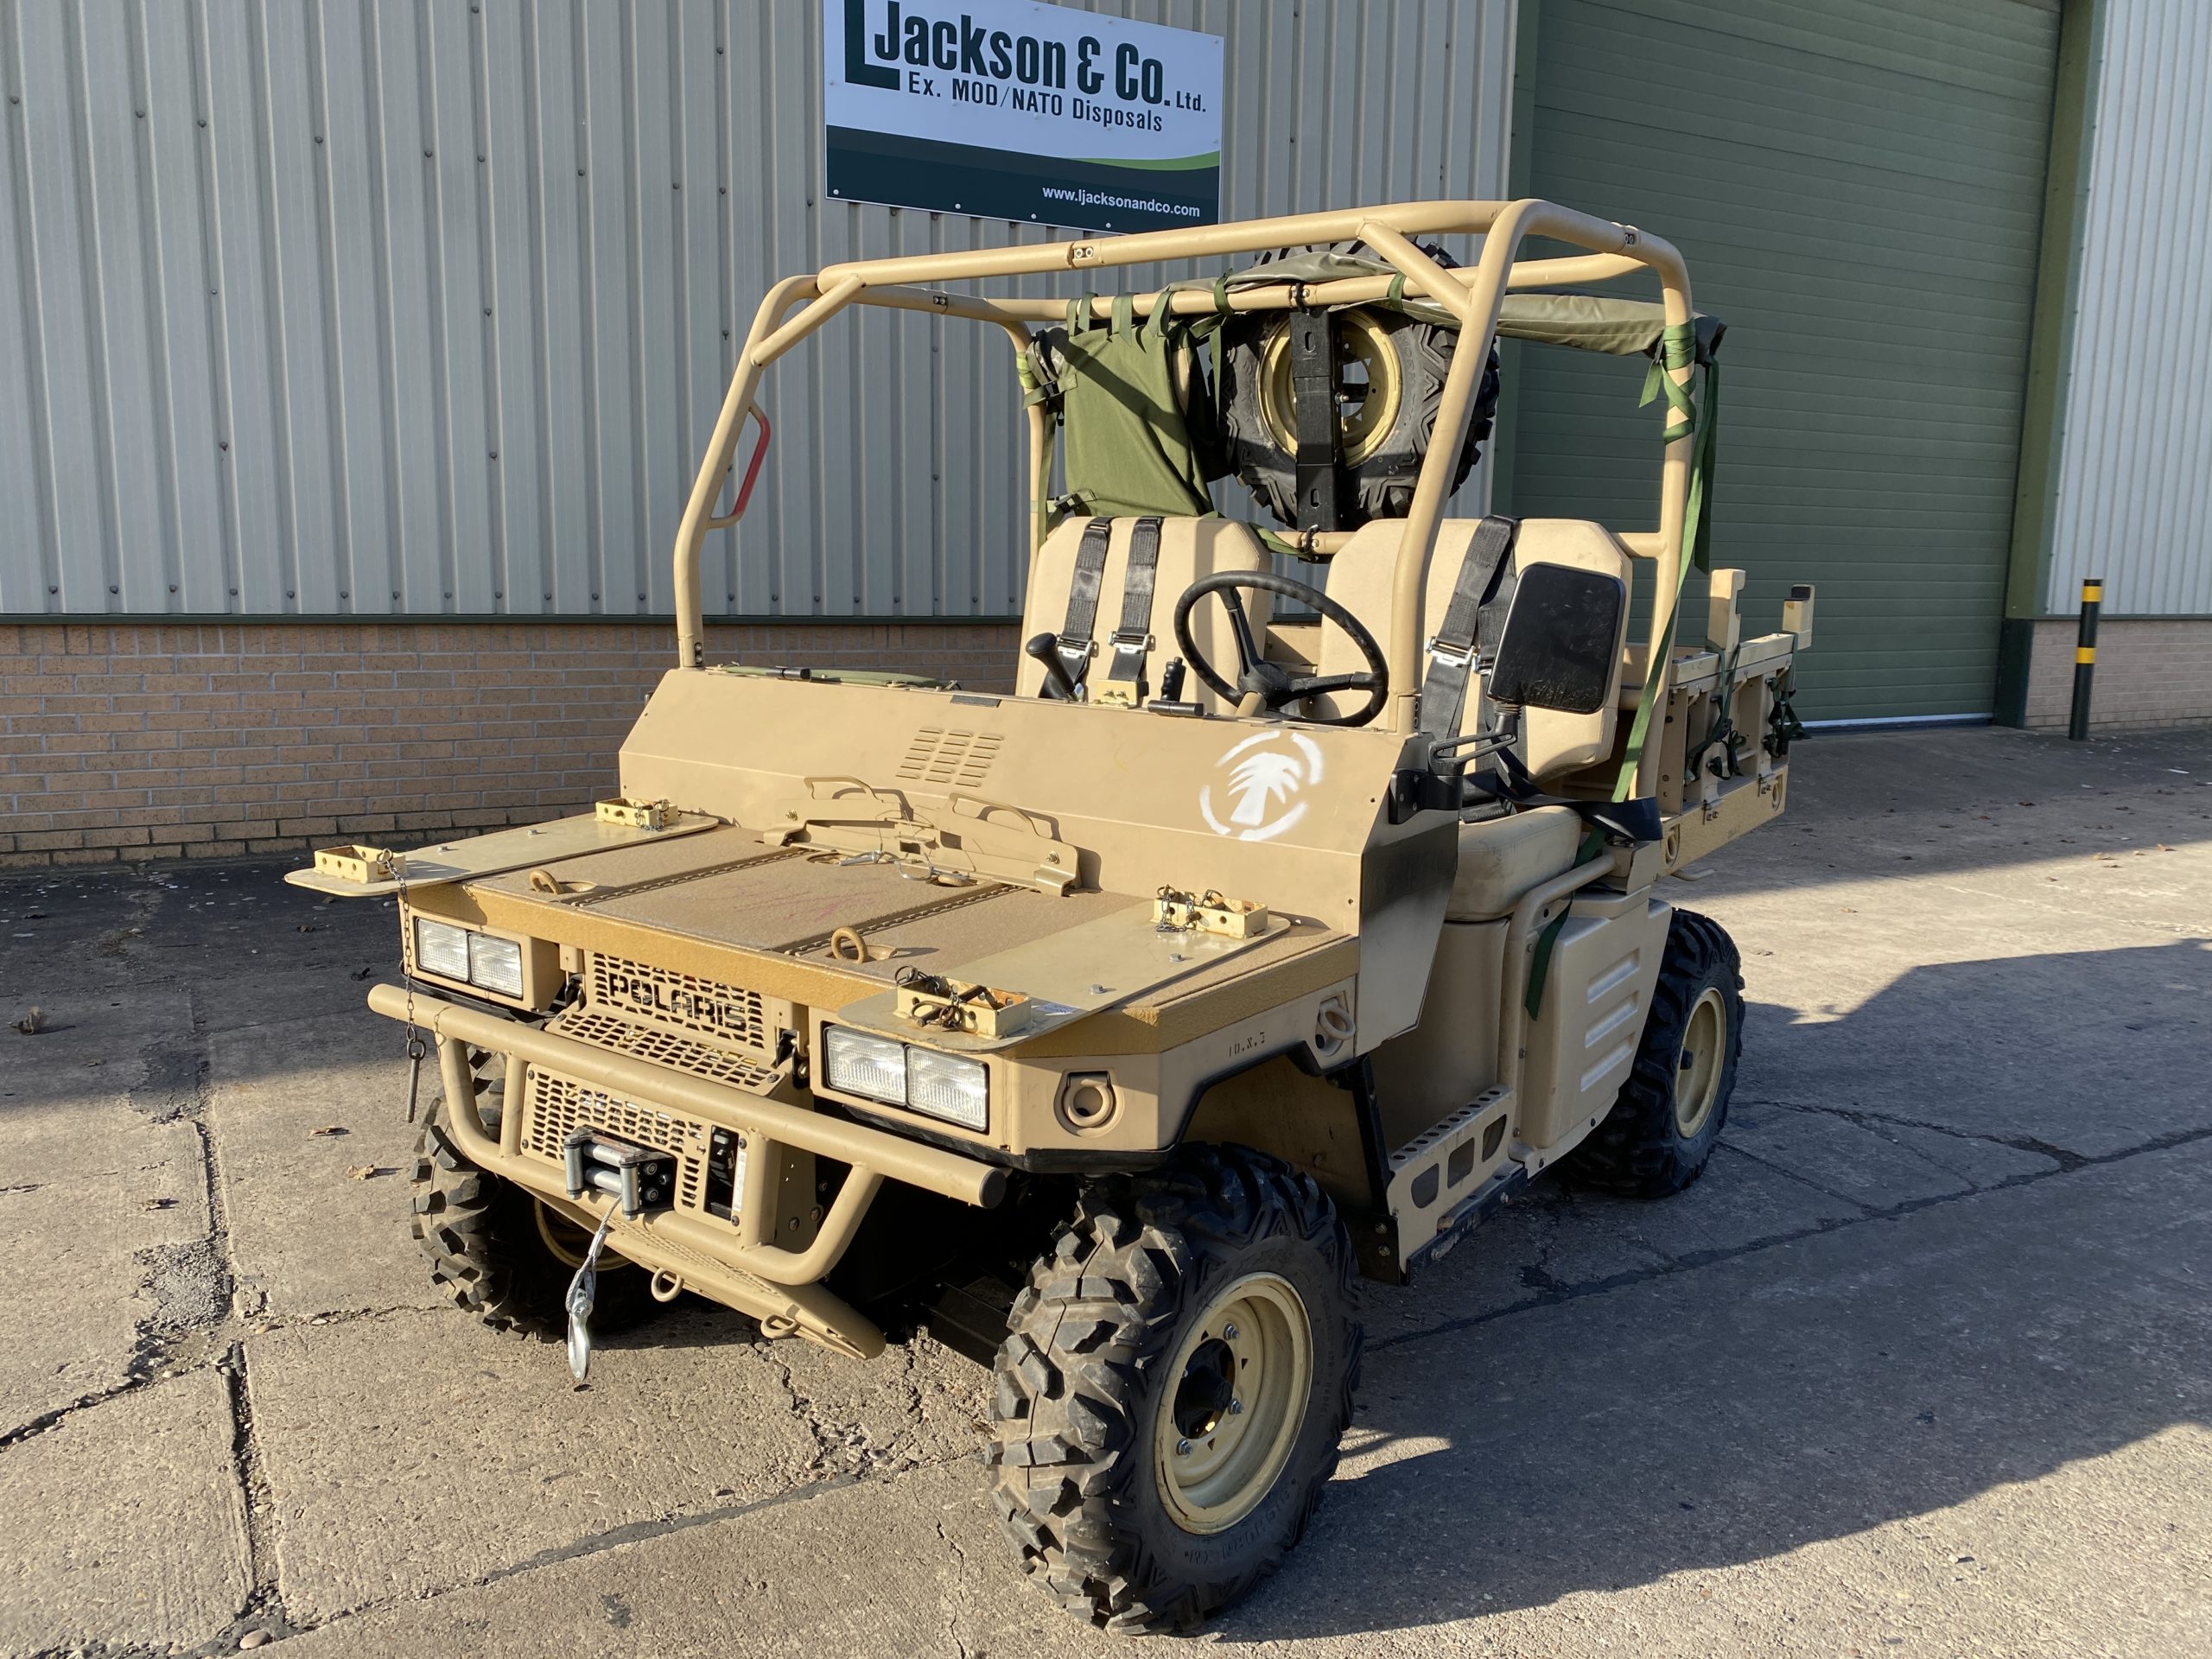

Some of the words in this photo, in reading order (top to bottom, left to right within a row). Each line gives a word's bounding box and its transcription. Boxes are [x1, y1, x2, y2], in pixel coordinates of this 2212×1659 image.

[909, 71, 941, 98] Ex.
[952, 79, 1063, 116] MOD/NATO
[1072, 99, 1163, 132] Disposals
[1077, 36, 1104, 94] &
[1116, 43, 1171, 106] Co.
[1176, 91, 1207, 112] Ltd.
[1042, 186, 1200, 217] www.ljacksonandco.com
[608, 973, 747, 1032] POLARIS
